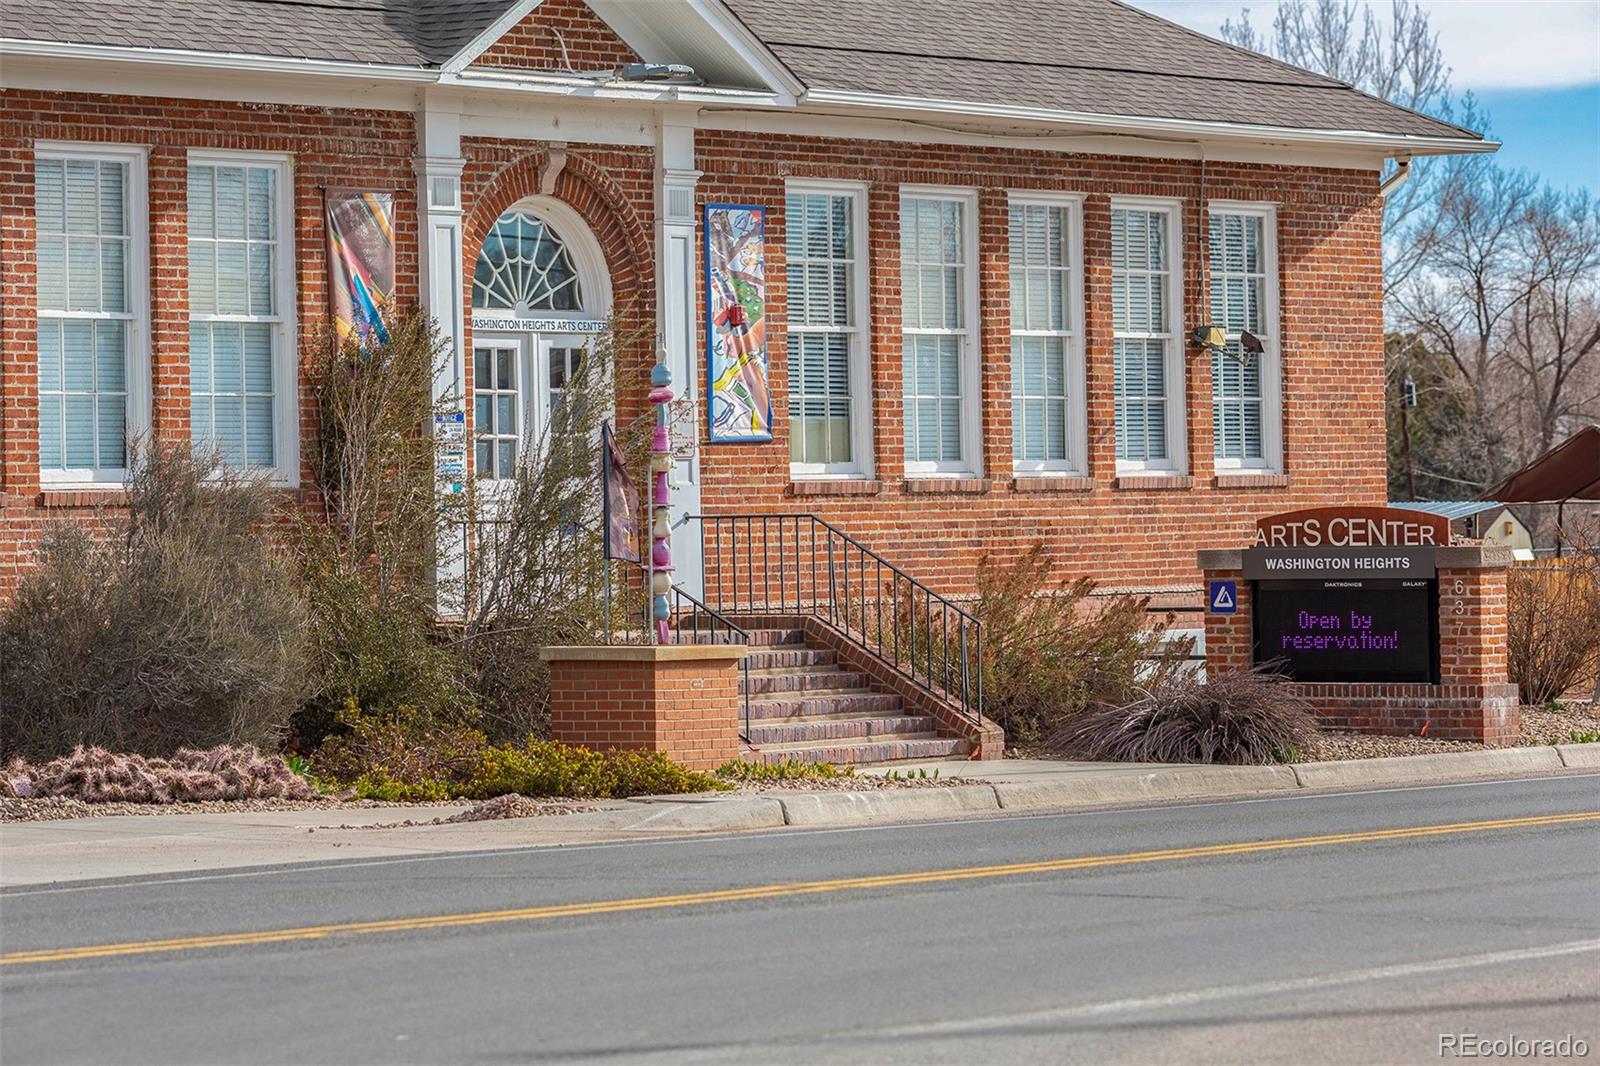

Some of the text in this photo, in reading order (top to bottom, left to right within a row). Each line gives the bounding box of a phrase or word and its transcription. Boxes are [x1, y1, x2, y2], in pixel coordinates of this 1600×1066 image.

[473, 319, 520, 330] ASHINGTON
[521, 320, 556, 331] HEIGHTS
[556, 321, 576, 331] ARTS
[1255, 517, 1435, 547] ARTS CENTER
[1265, 557, 1411, 571] WASHINGTON HEIGHTS
[1298, 611, 1372, 629] Open by
[1281, 630, 1399, 649] reservation!
